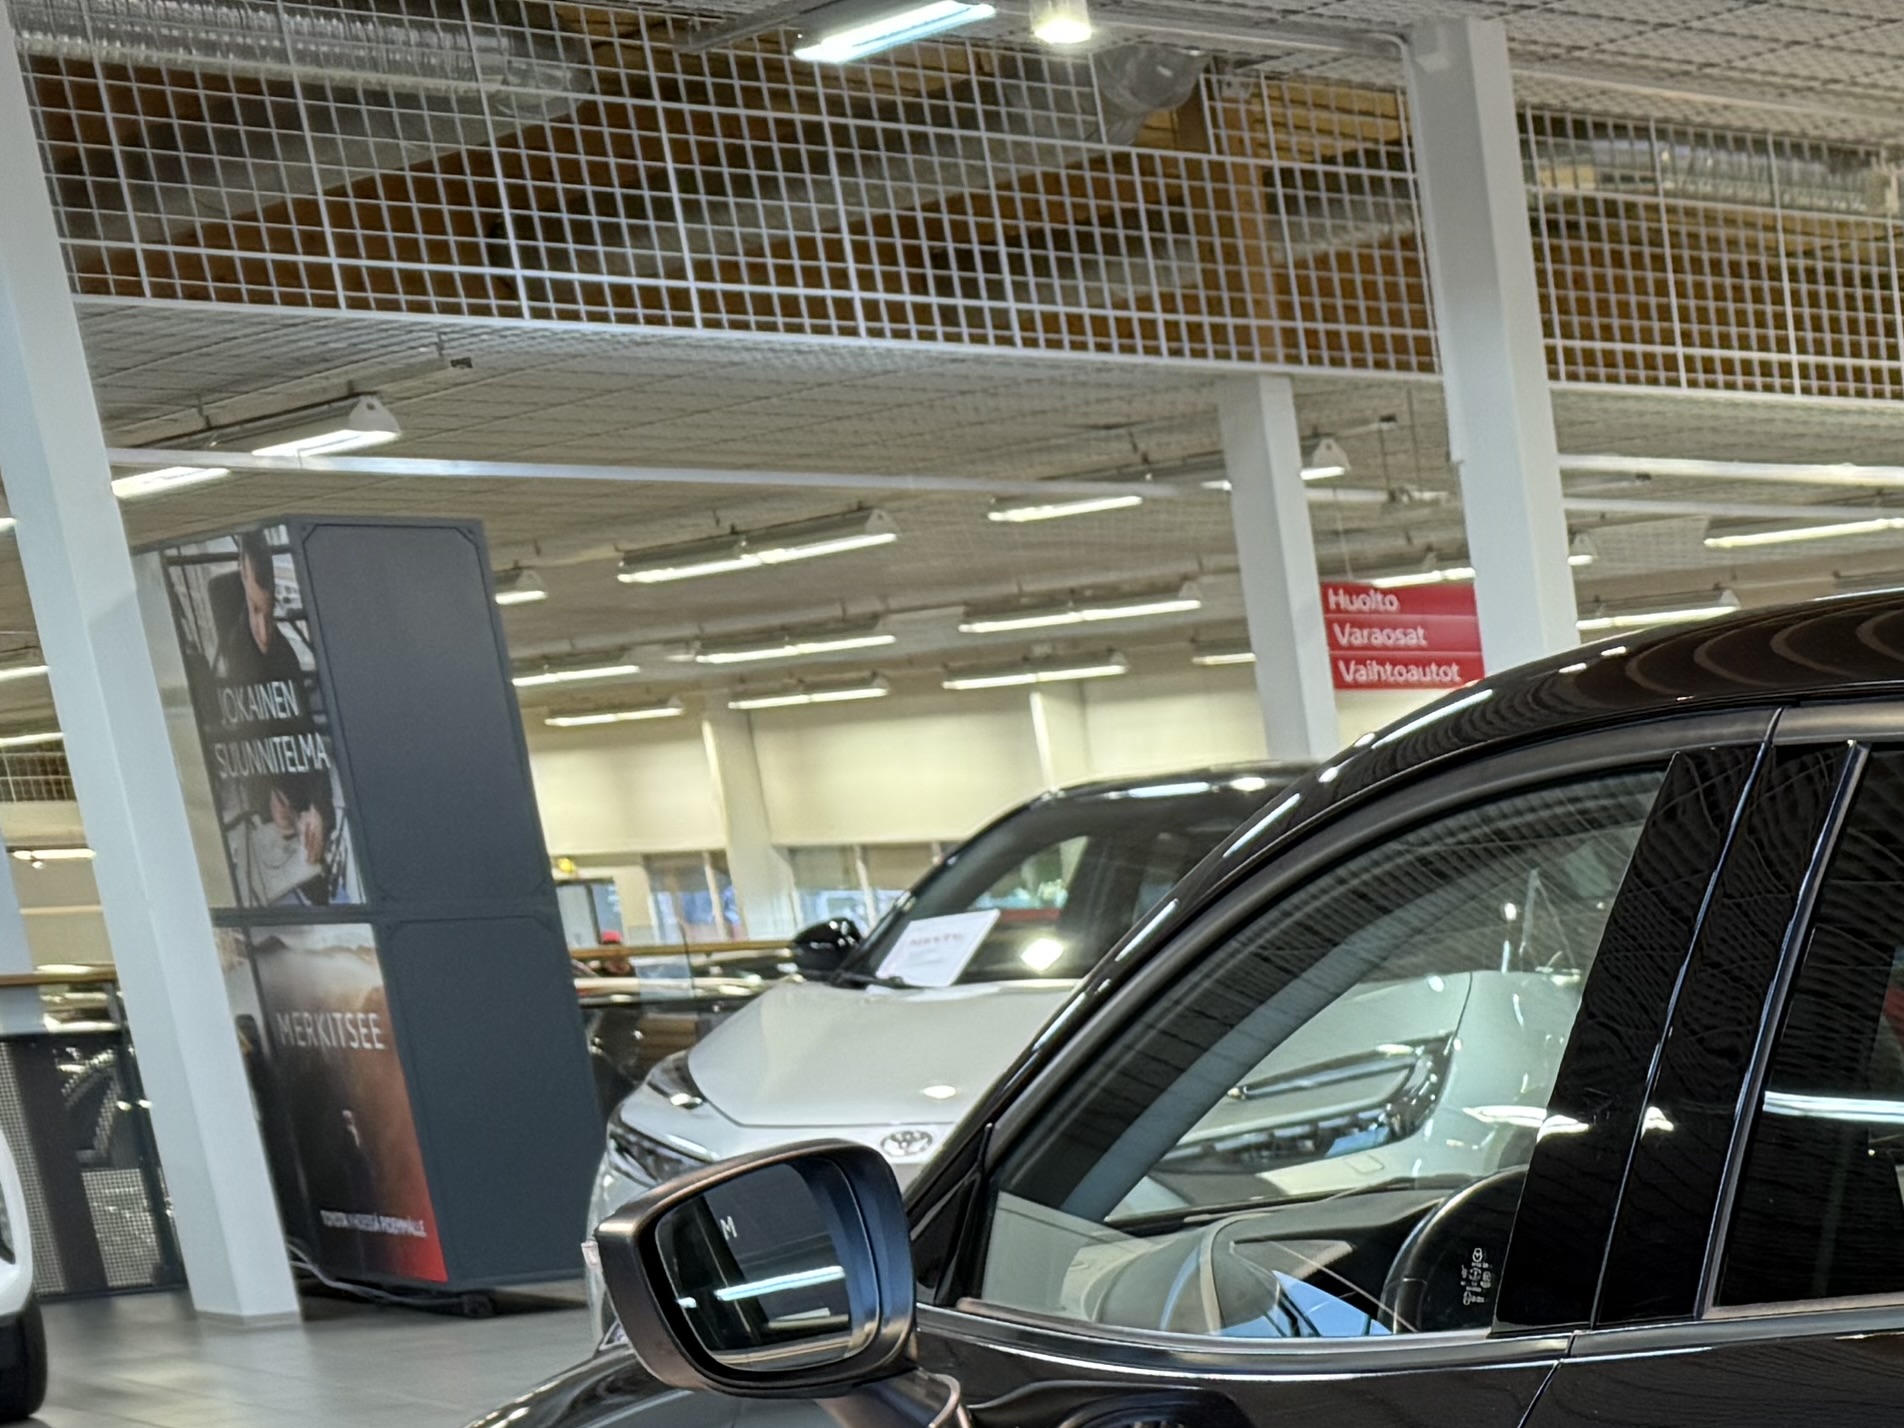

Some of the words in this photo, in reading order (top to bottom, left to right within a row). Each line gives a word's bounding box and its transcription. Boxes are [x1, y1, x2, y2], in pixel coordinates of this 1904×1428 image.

[1327, 586, 1400, 613] Huolto
[1332, 622, 1428, 648] Varaosat
[1338, 659, 1462, 685] Vaihtoautot
[216, 679, 299, 725] JOKAINEN
[213, 731, 331, 780] SUUNNITELMA
[275, 1011, 388, 1050] MERKITSEE
